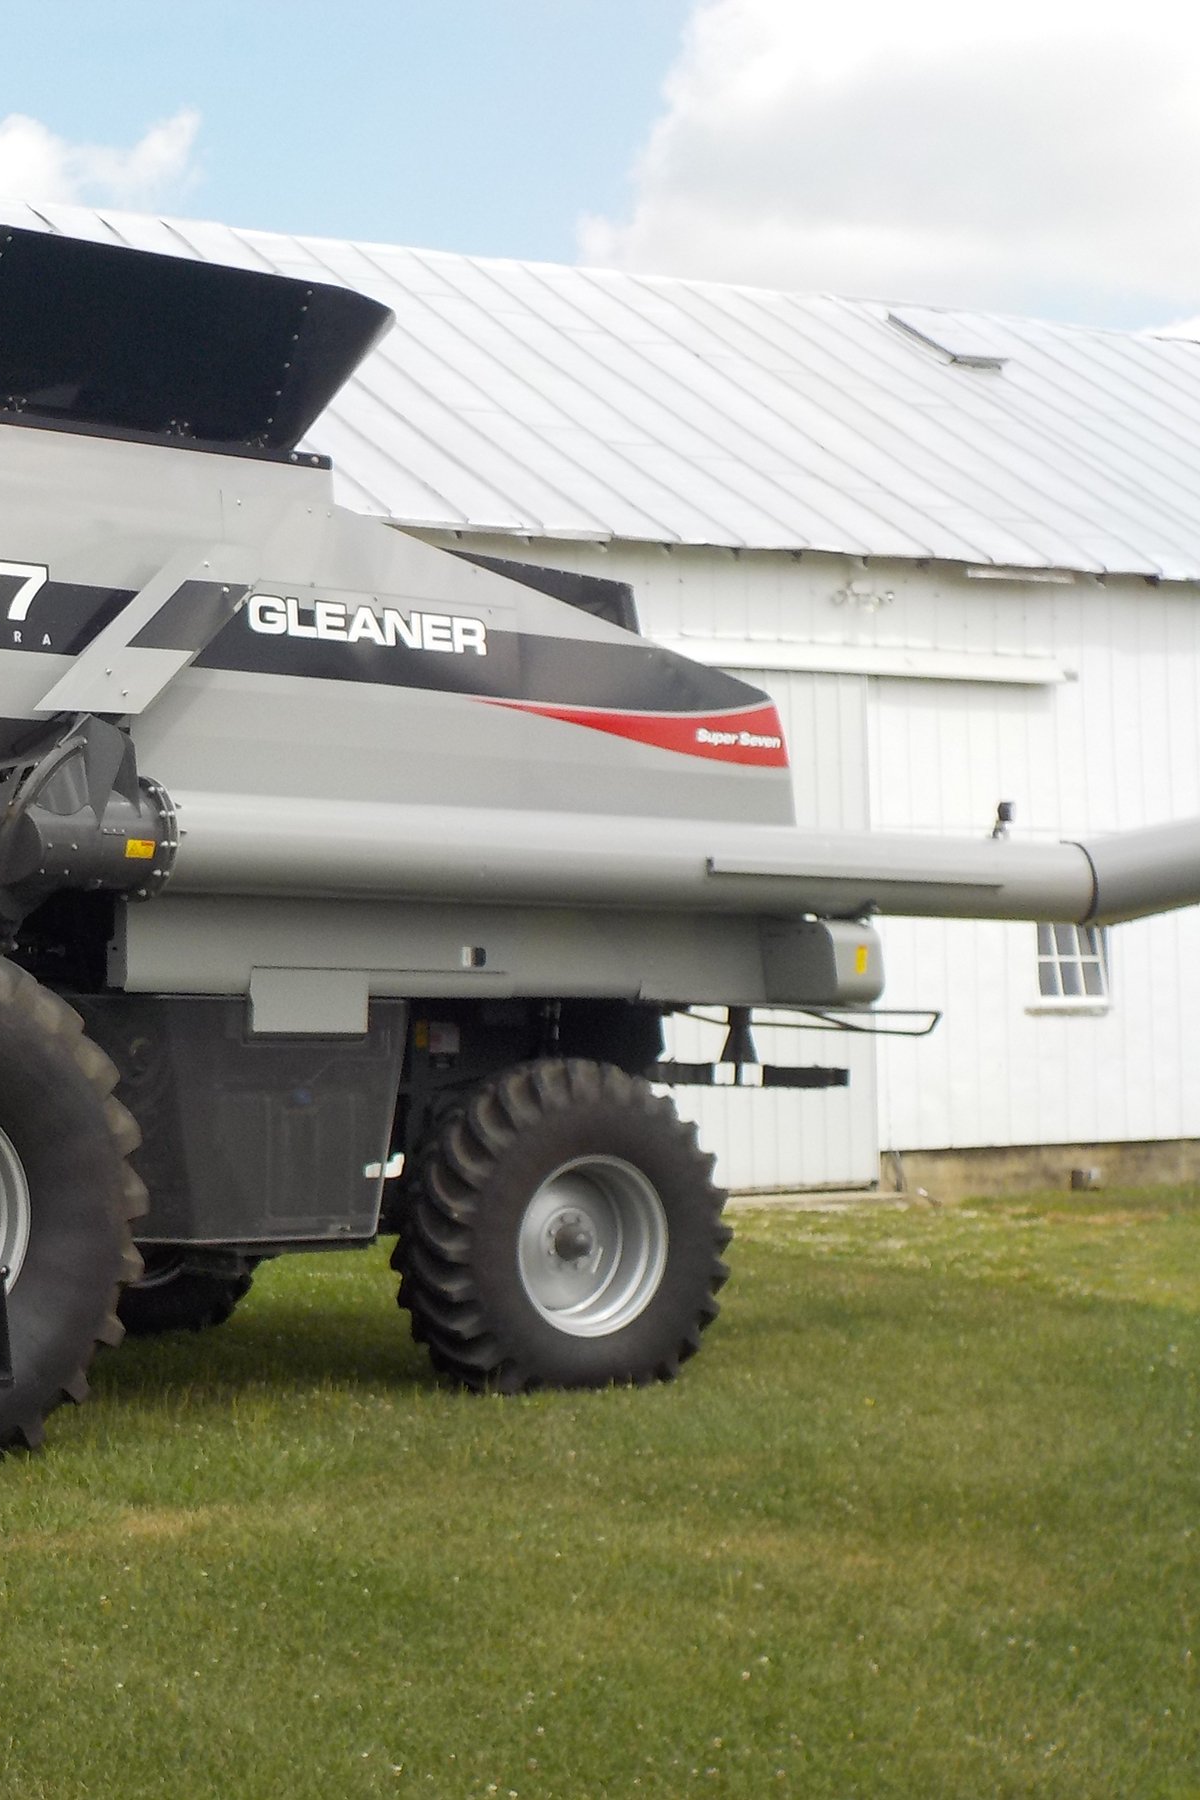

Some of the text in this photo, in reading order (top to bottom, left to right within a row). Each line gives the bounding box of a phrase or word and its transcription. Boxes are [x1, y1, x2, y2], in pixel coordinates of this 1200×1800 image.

[248, 594, 488, 657] GLEANER
[696, 727, 782, 749] Super Seven
